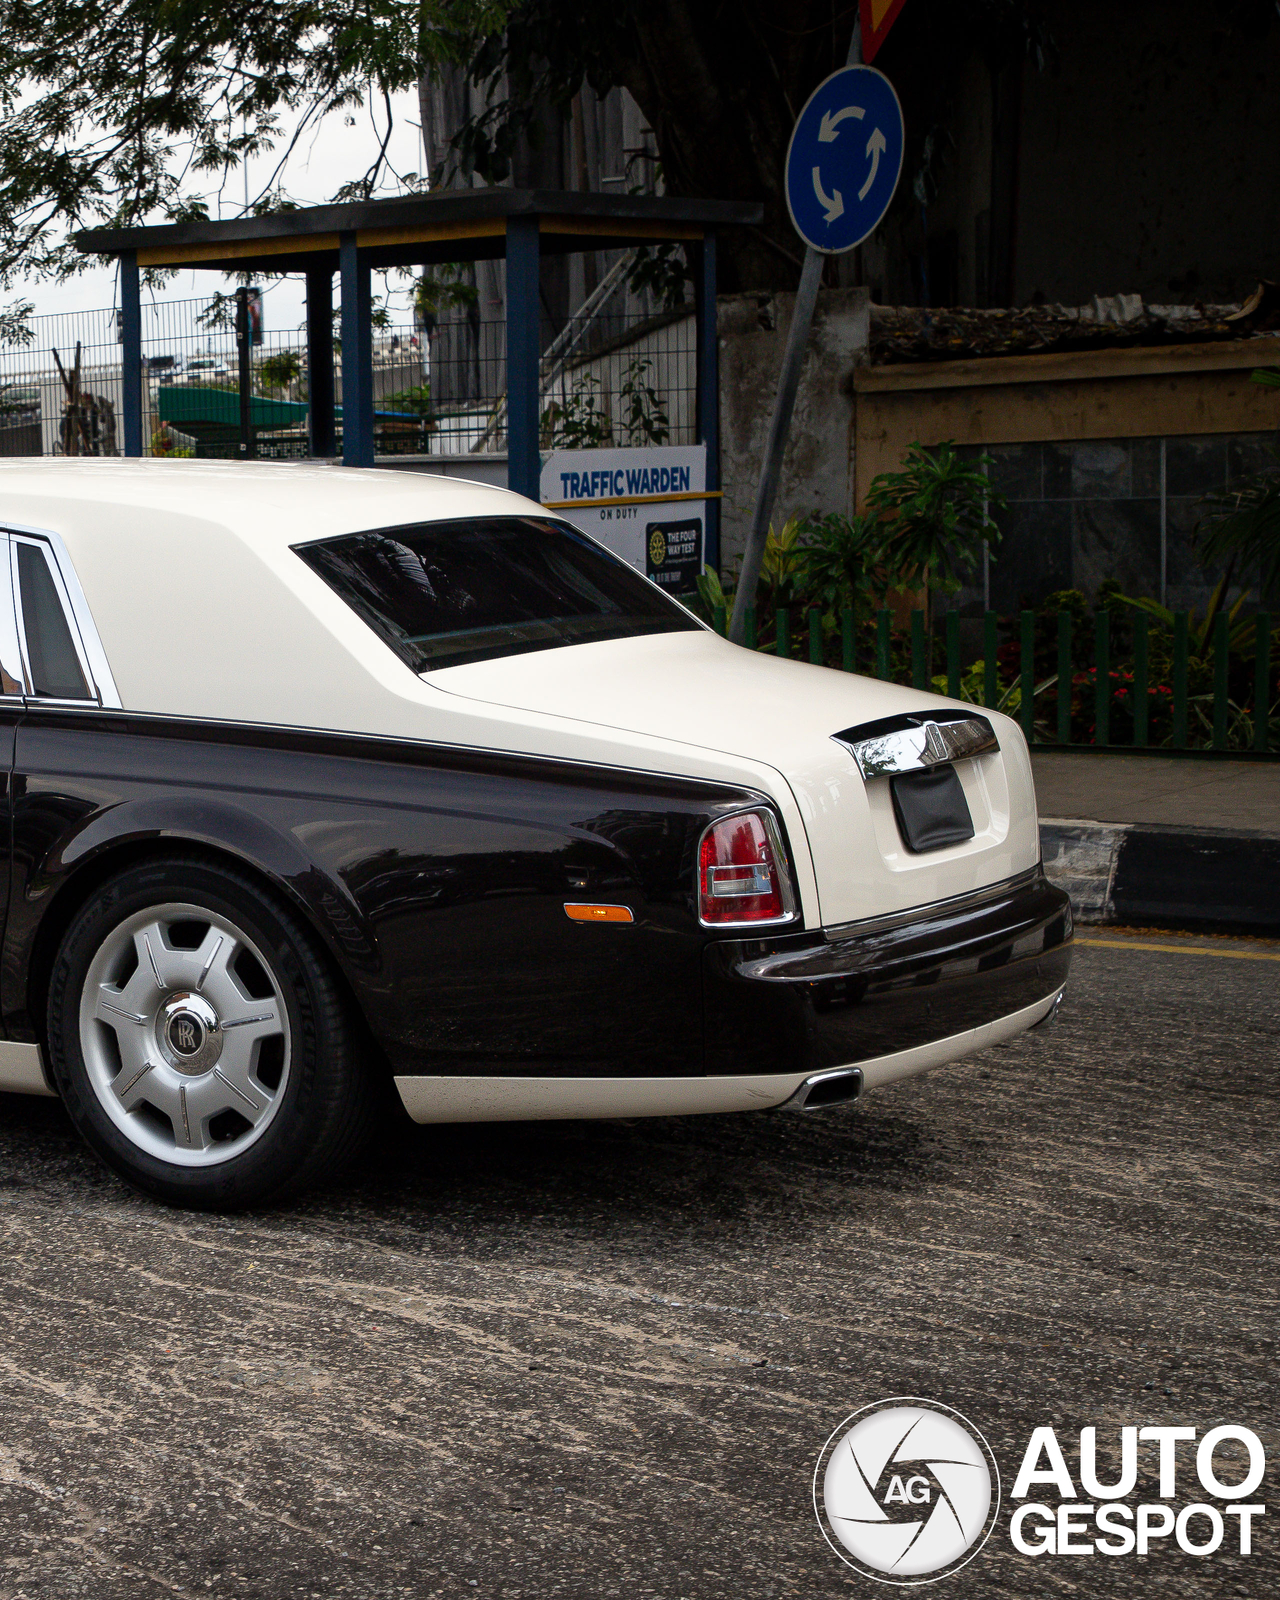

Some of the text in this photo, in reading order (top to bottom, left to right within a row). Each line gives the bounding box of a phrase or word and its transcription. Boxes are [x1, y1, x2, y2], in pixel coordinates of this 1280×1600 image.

[560, 466, 690, 499] TRAFFIC WARDEN
[600, 507, 638, 520] ON DUTY
[667, 529, 697, 543] THE FOUR
[667, 542, 695, 556] WAY TEST
